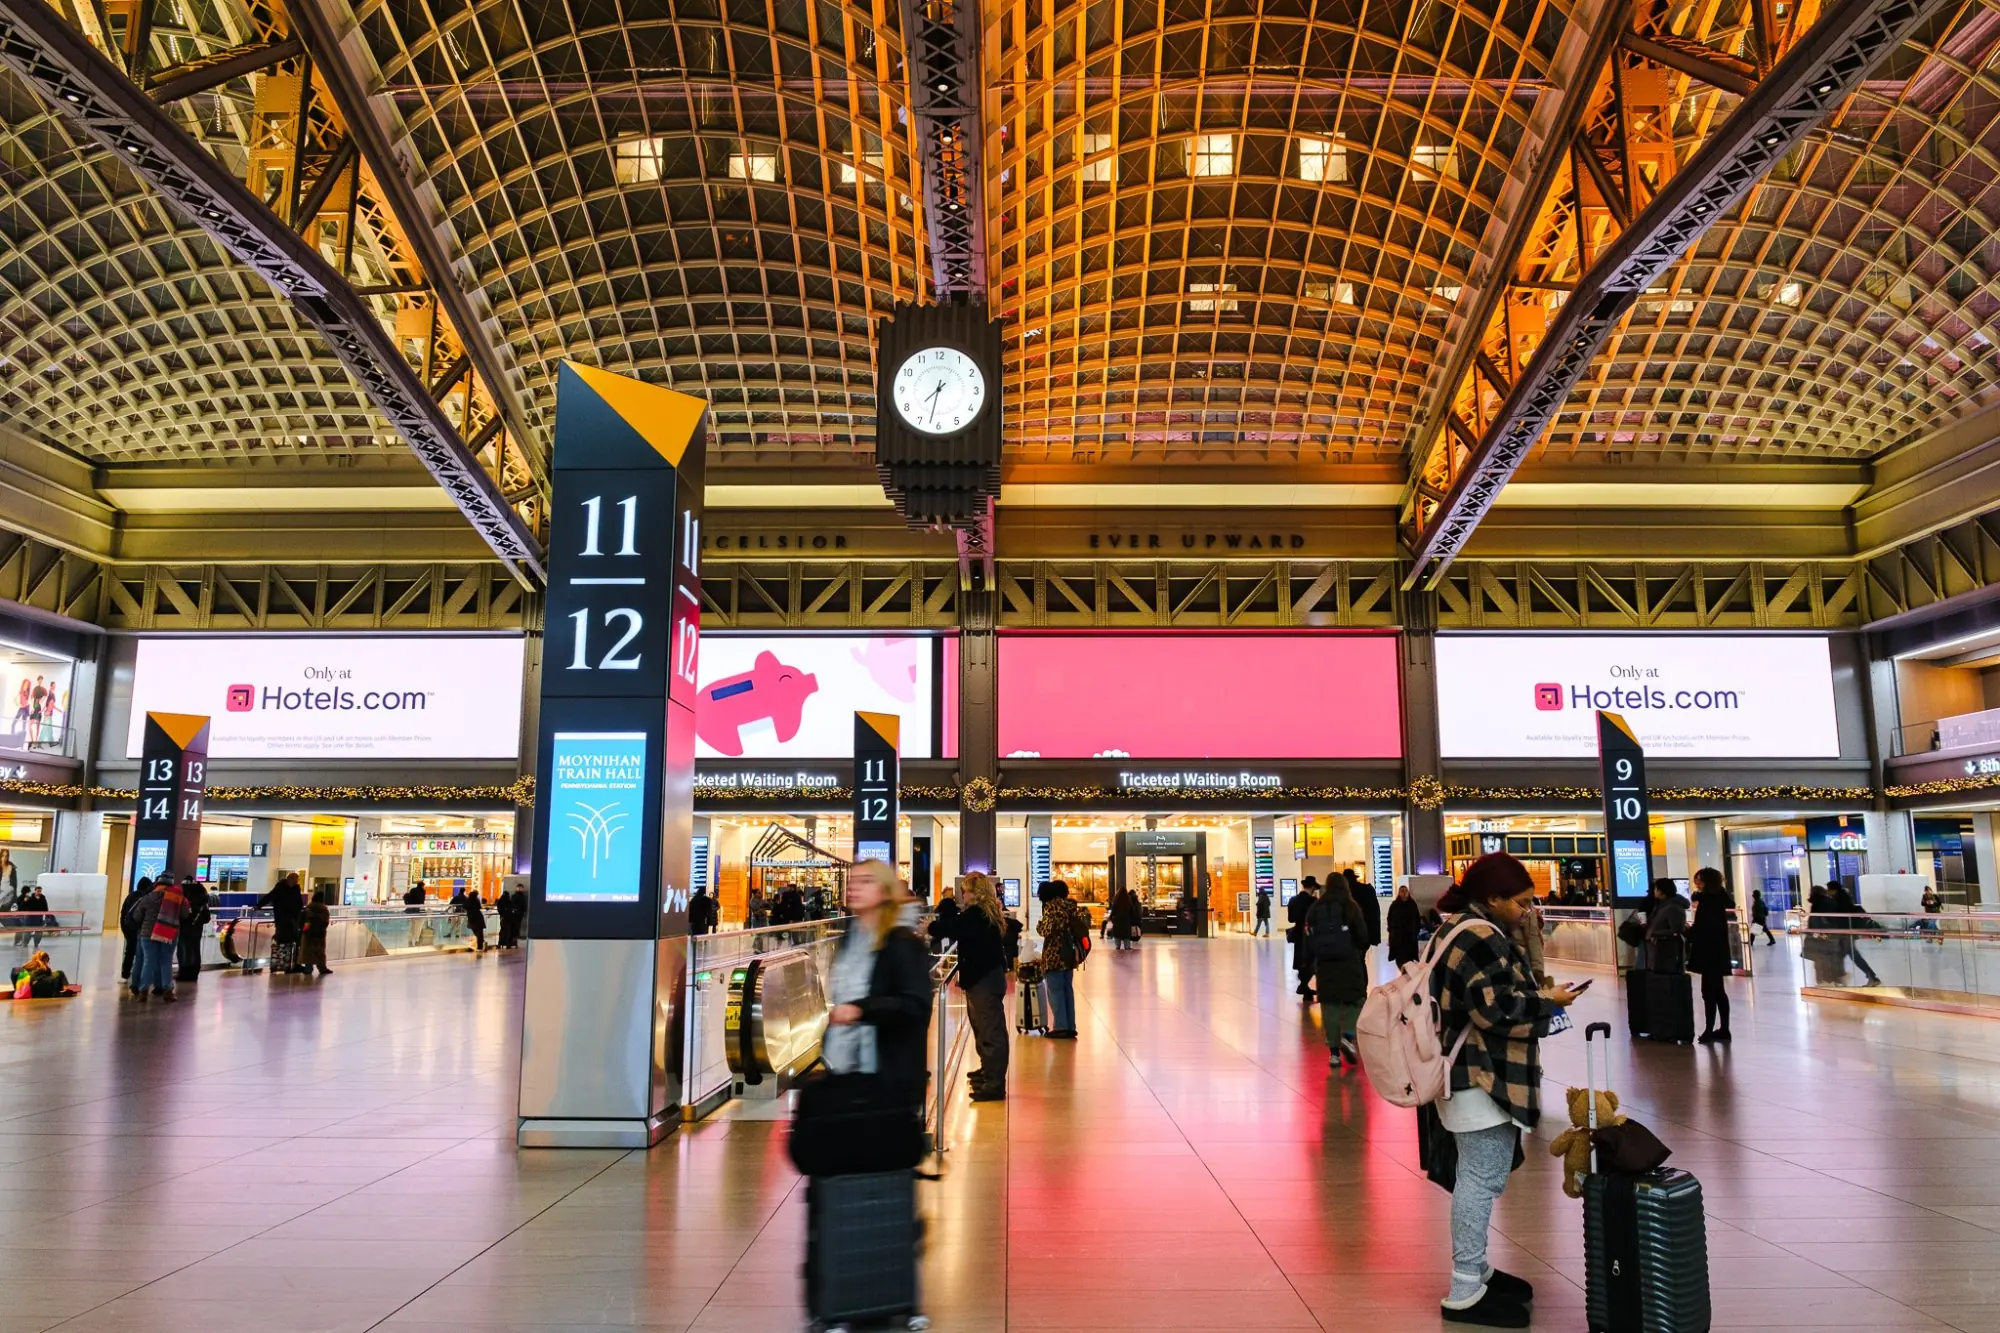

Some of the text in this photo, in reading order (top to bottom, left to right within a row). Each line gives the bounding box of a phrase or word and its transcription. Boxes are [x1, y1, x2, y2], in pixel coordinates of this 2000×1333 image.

[918, 355, 926, 364] 11
[935, 351, 945, 360] 12
[957, 355, 962, 364] 1
[903, 368, 913, 377] 10
[968, 368, 975, 378] 2
[899, 386, 905, 394] 9
[973, 386, 980, 395] 3
[903, 403, 910, 412] 8
[967, 403, 974, 412] 4
[917, 416, 923, 425] 7
[935, 421, 942, 430] 6
[953, 416, 960, 426] 5
[577, 495, 642, 557] 11
[682, 509, 699, 577] 11
[1089, 534, 1305, 549] EVER UPWARD
[565, 607, 644, 670] 12
[676, 616, 697, 685] 12
[304, 666, 352, 682] Only at
[1610, 665, 1660, 681] Only at
[558, 754, 642, 767] MOYNIHAN
[148, 759, 173, 781] 13
[186, 761, 203, 783] 13
[556, 767, 642, 780] TRAIN HALL
[863, 759, 887, 782] 11
[1615, 758, 1633, 780] 9
[740, 773, 793, 788] Waiting
[796, 773, 838, 787] Room
[1119, 772, 1282, 788] Ticketed Waiting Room
[142, 797, 170, 820] 14
[181, 799, 200, 821] 14
[861, 798, 889, 821] 12
[1613, 797, 1642, 820] 10
[406, 840, 423, 851] ICE
[429, 840, 466, 851] CREAM
